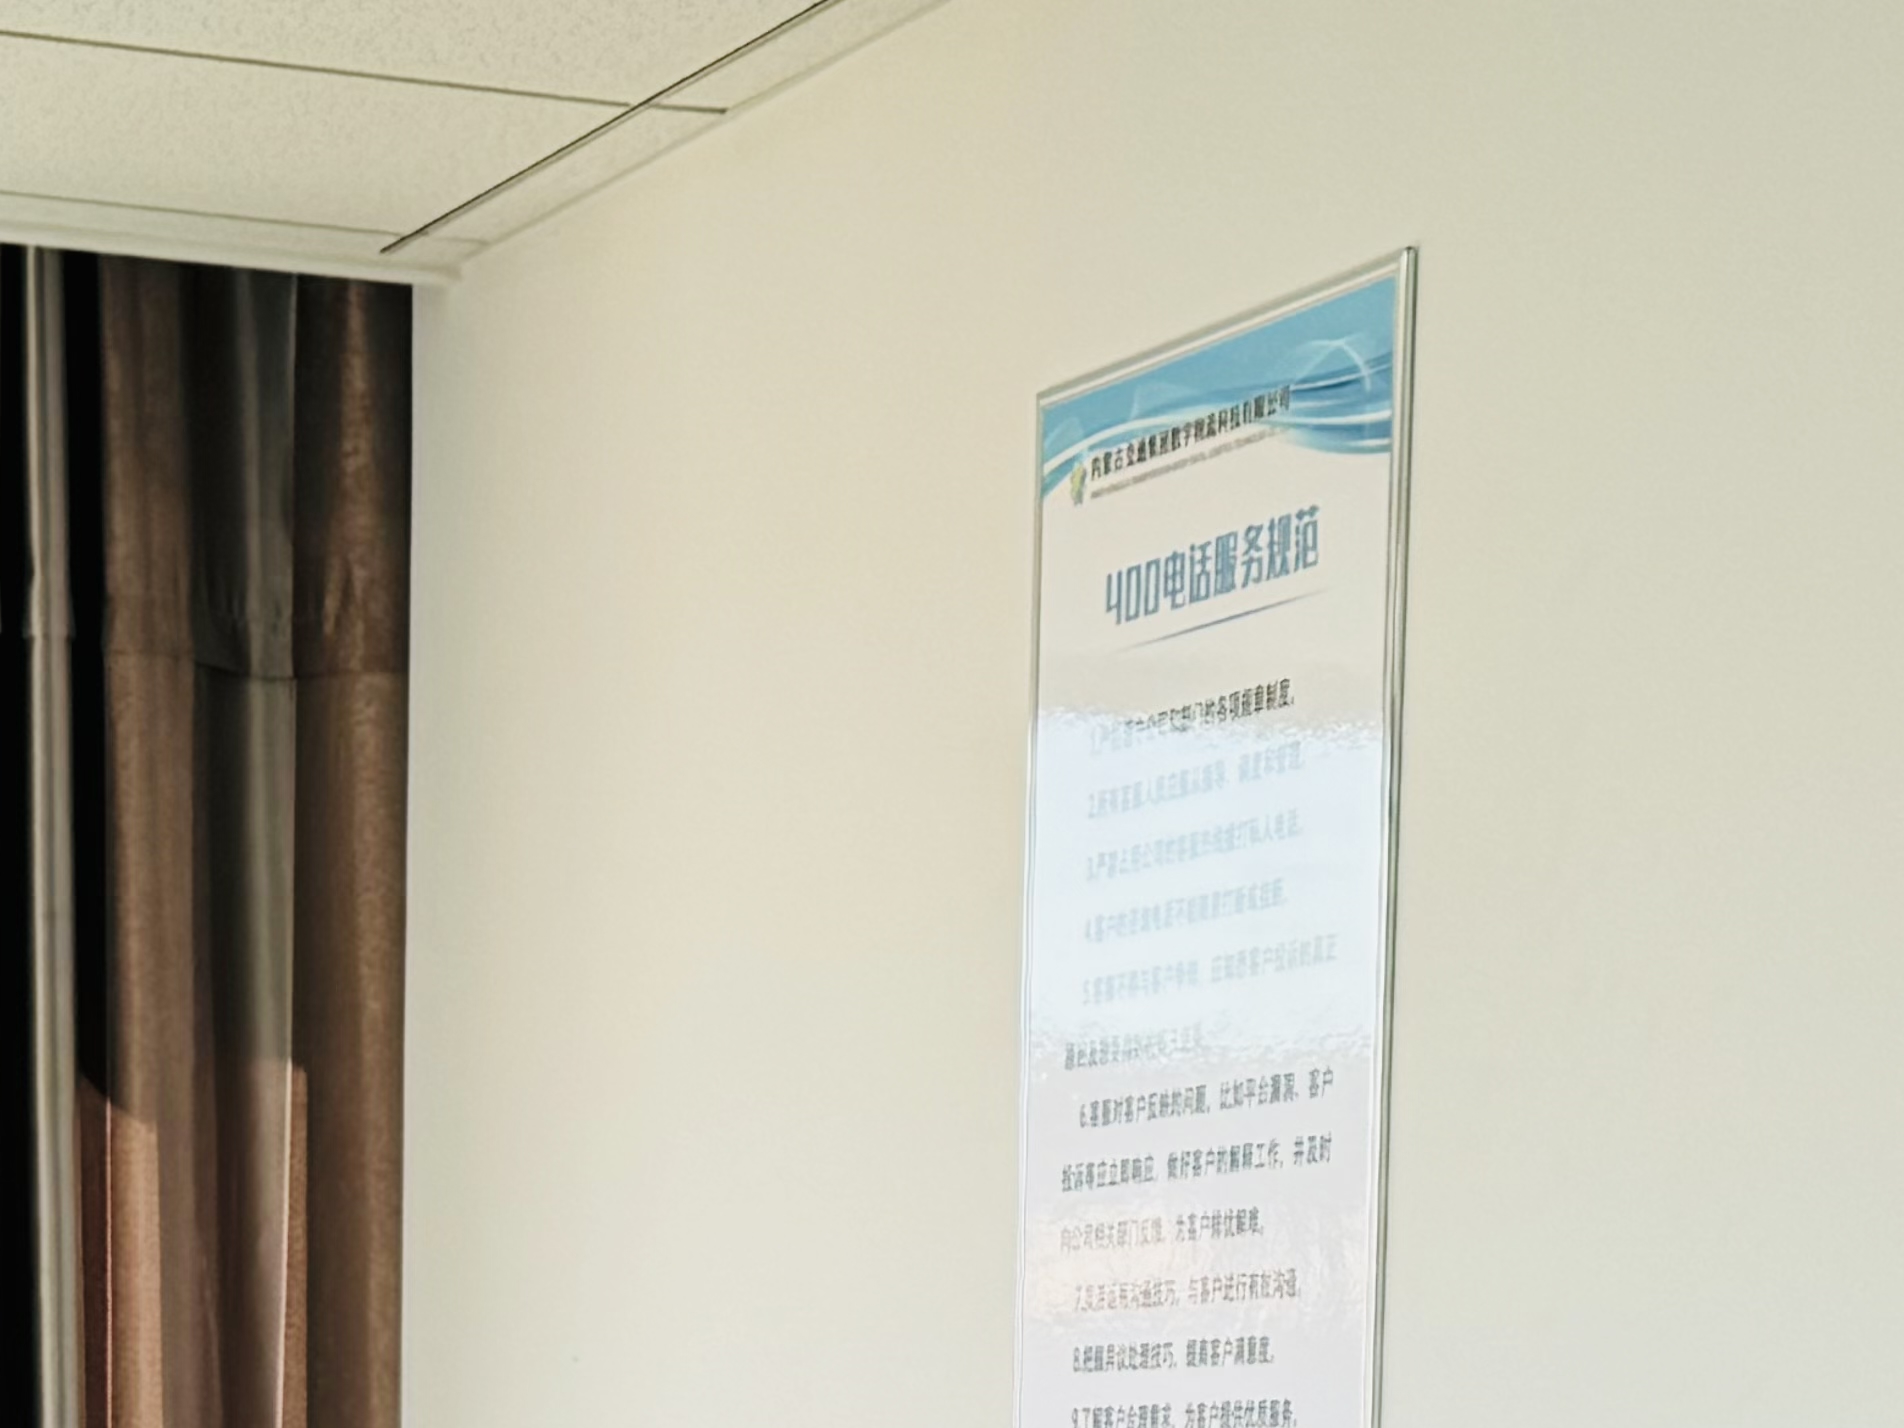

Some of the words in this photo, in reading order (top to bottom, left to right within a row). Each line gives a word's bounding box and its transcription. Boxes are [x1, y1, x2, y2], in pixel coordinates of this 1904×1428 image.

[1105, 504, 1320, 626] 400电话服务规范
